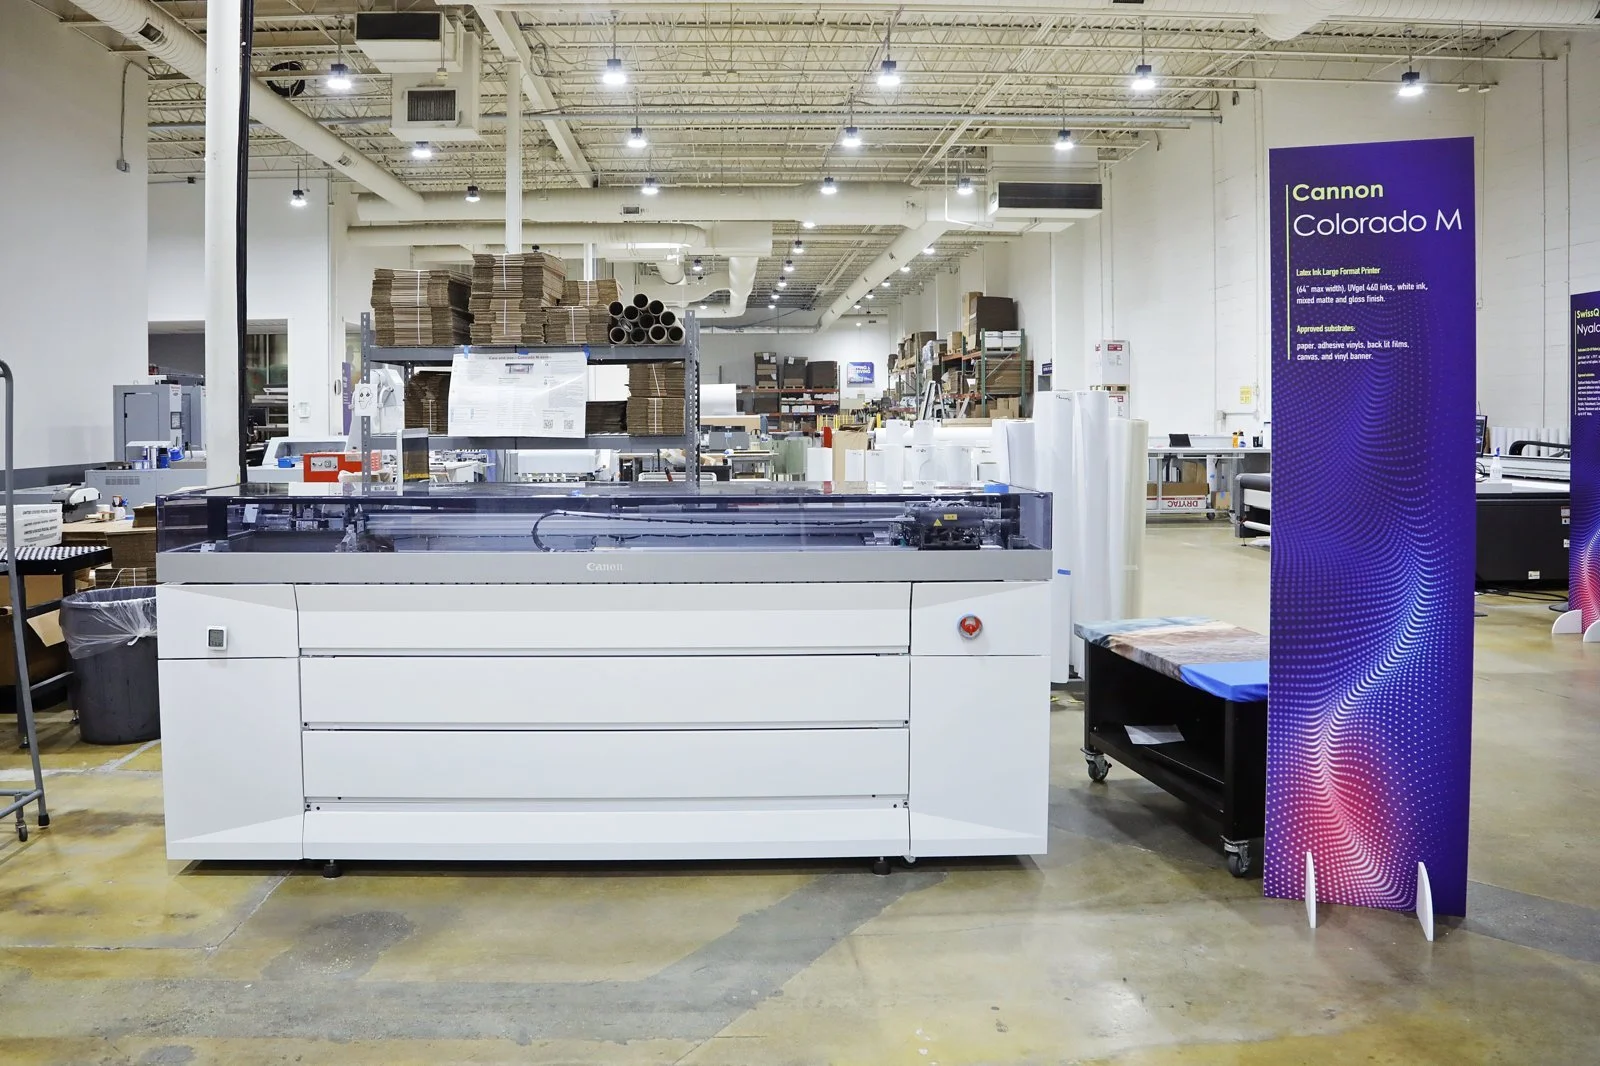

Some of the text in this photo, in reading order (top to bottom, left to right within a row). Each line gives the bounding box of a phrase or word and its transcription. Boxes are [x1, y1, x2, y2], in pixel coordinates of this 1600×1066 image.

[1292, 183, 1384, 202] Cannon
[1293, 208, 1463, 237] Colorado M
[1296, 266, 1381, 277] Latex Ink Large Format Printer
[1347, 284, 1365, 293] UVgel
[1366, 283, 1379, 291] 460
[1380, 283, 1395, 292] inks,
[1397, 282, 1415, 290] white
[1416, 282, 1429, 291] ink,
[1296, 296, 1315, 304] mixed
[1316, 296, 1334, 304] matte
[1348, 295, 1366, 305] gloss
[1366, 294, 1386, 303] finish.
[1296, 324, 1356, 334] Approved substrates:
[1317, 341, 1345, 350] adhesive
[1367, 341, 1383, 349] back
[1383, 340, 1391, 348] lit
[1321, 353, 1334, 361] and
[1334, 352, 1349, 361] vinyl
[1349, 351, 1374, 360] banner.
[1167, 500, 1199, 508] DRYTAC
[586, 562, 623, 571] Canon
